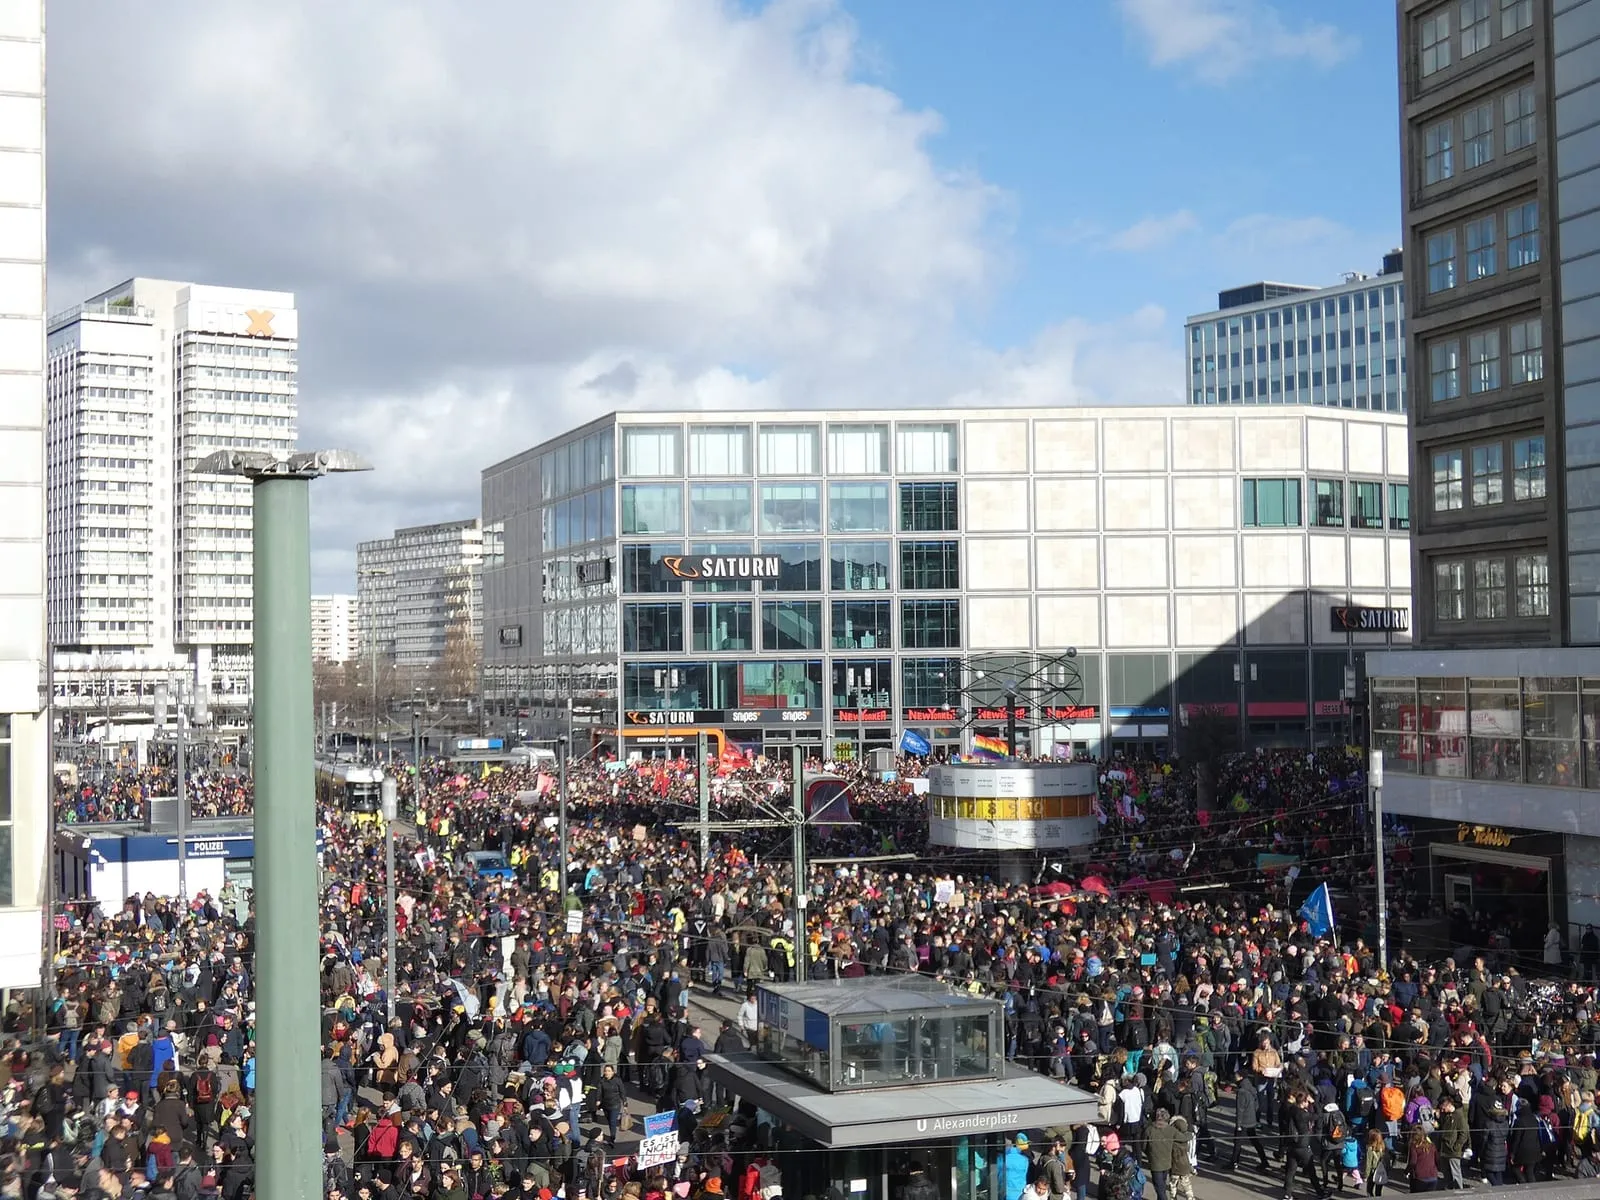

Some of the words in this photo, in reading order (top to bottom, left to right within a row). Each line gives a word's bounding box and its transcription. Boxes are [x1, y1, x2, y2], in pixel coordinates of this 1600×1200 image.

[702, 557, 779, 577] SATURN
[1360, 609, 1408, 629] SATURN
[649, 711, 694, 724] SATURN
[194, 841, 224, 851] POLIZEI
[932, 1111, 1018, 1131] Alexanderplatz
[643, 1139, 656, 1148] ES
[660, 1133, 677, 1143] IST
[646, 1140, 675, 1155] NICHT
